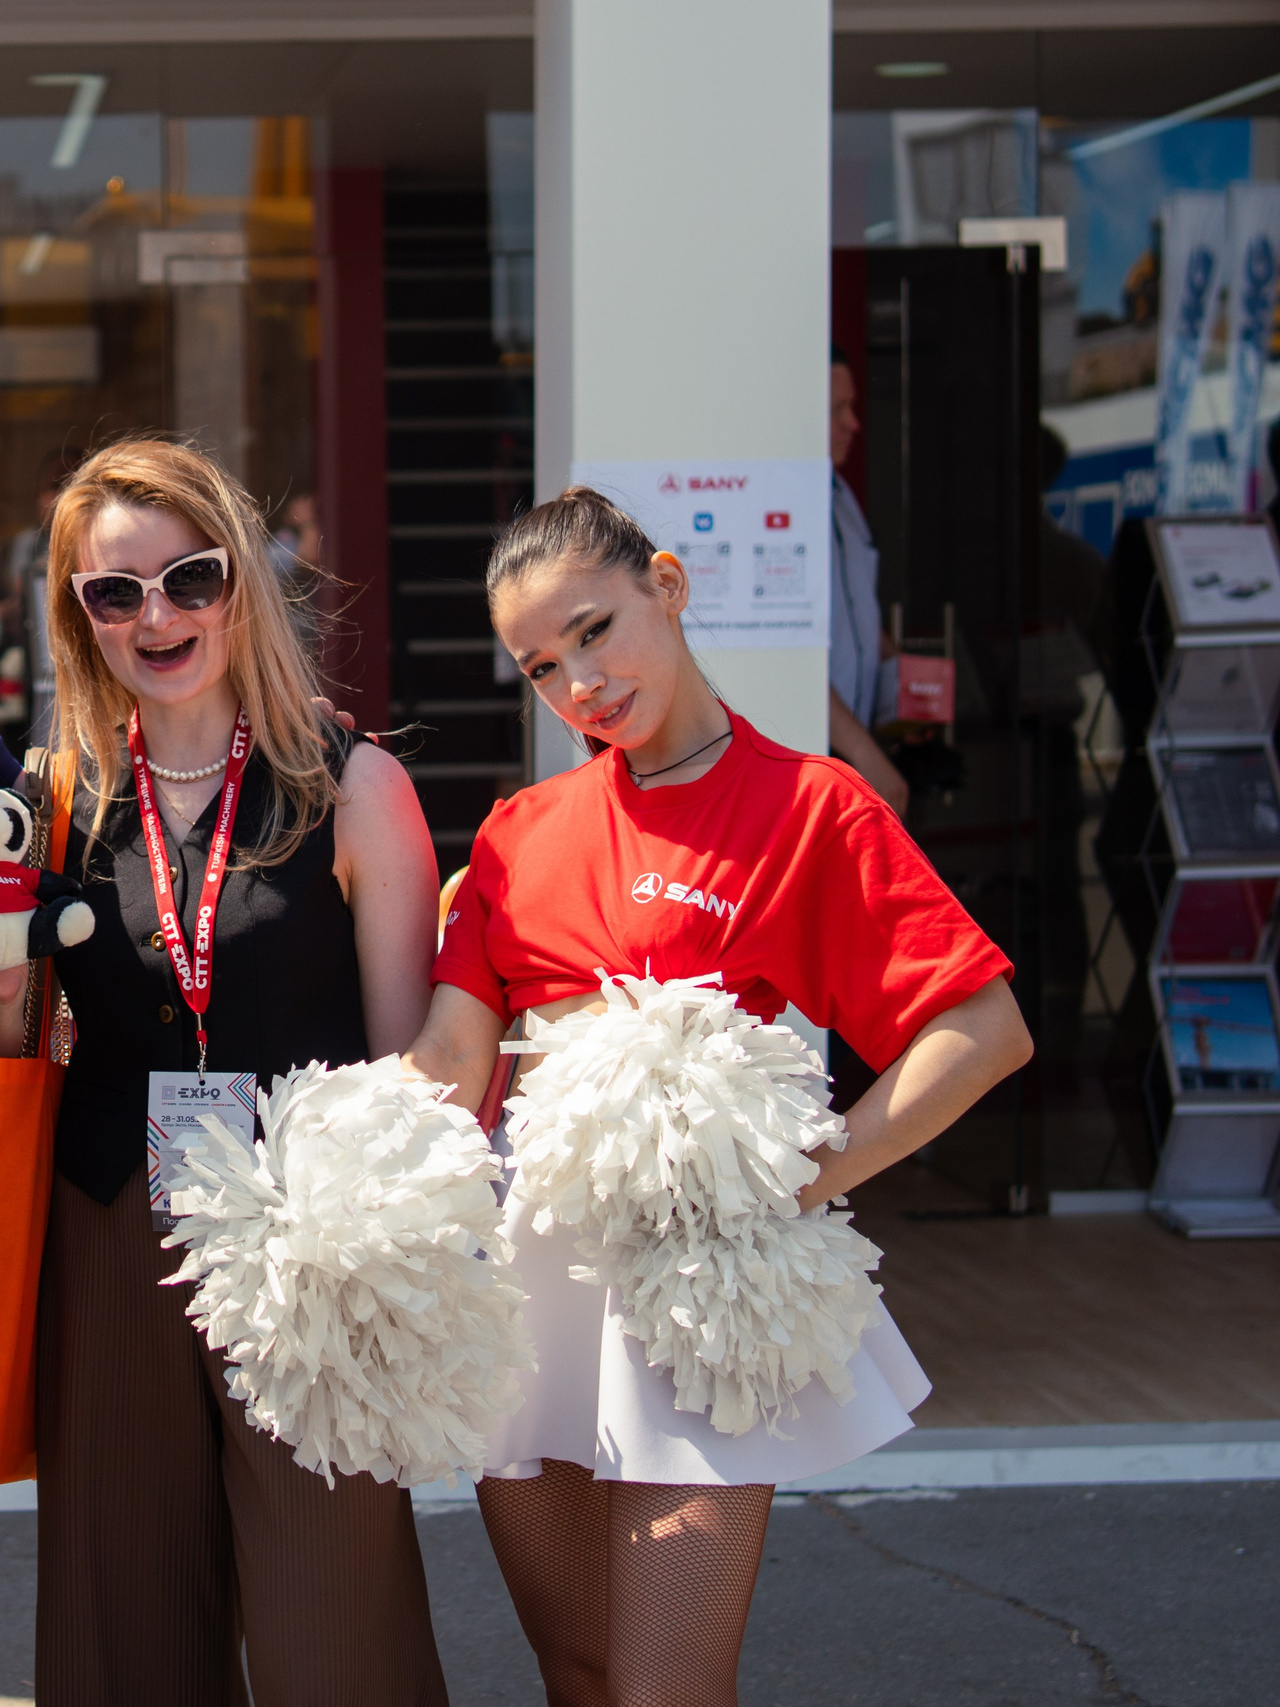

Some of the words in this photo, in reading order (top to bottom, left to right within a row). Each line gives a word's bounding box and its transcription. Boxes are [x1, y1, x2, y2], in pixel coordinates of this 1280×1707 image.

[687, 475, 749, 493] SANY
[231, 729, 247, 759] CTT
[138, 767, 153, 811] ТУРЕЦКИЕ
[211, 833, 226, 870] TURKISH
[219, 781, 236, 832] MACHINERY
[664, 882, 744, 920] SANY
[196, 905, 213, 954] EXPO
[162, 912, 180, 940] CTT
[171, 943, 194, 991] EXPO
[195, 956, 208, 989] CTT
[178, 1087, 221, 1100] EXPO
